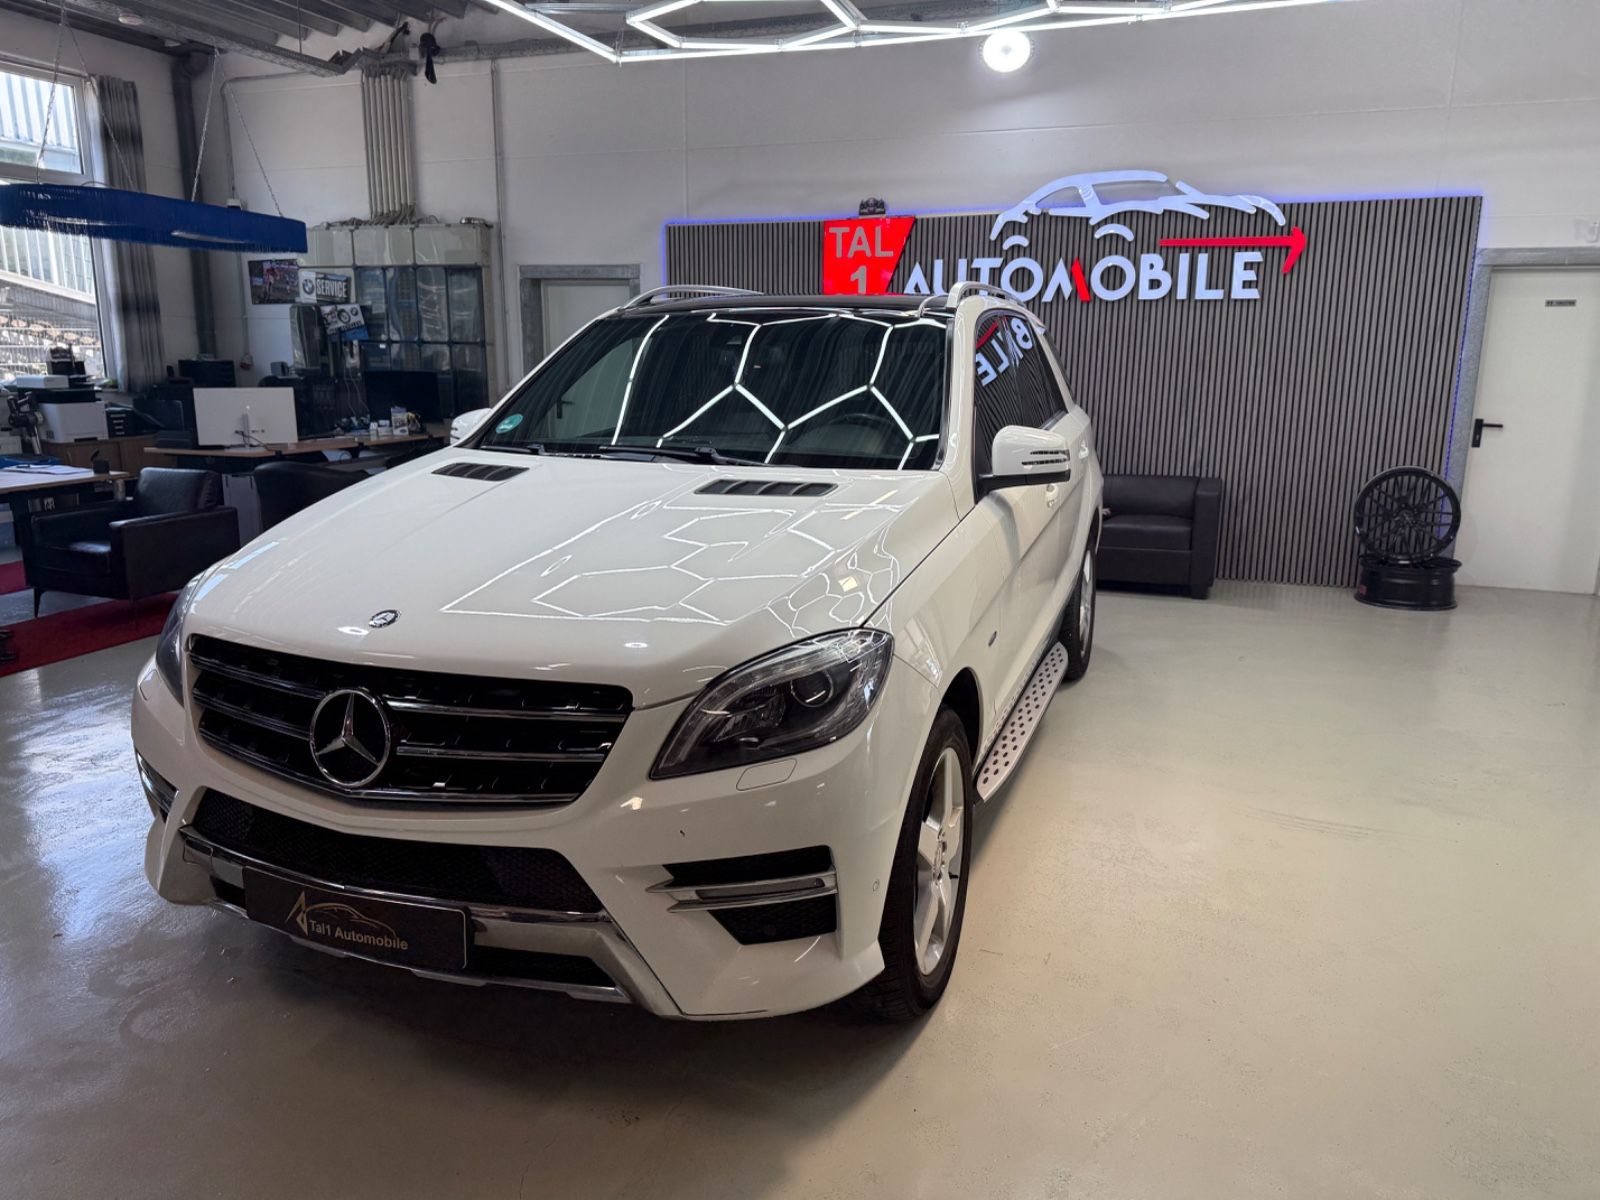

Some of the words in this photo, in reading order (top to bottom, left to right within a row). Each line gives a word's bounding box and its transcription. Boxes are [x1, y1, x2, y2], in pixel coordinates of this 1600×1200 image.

[828, 226, 894, 258] TAL
[316, 279, 347, 298] SERVICE
[850, 265, 867, 294] 1
[903, 251, 1264, 303] AUTOMOBILE
[309, 919, 331, 936] Tal1
[335, 927, 409, 950] Automobile
